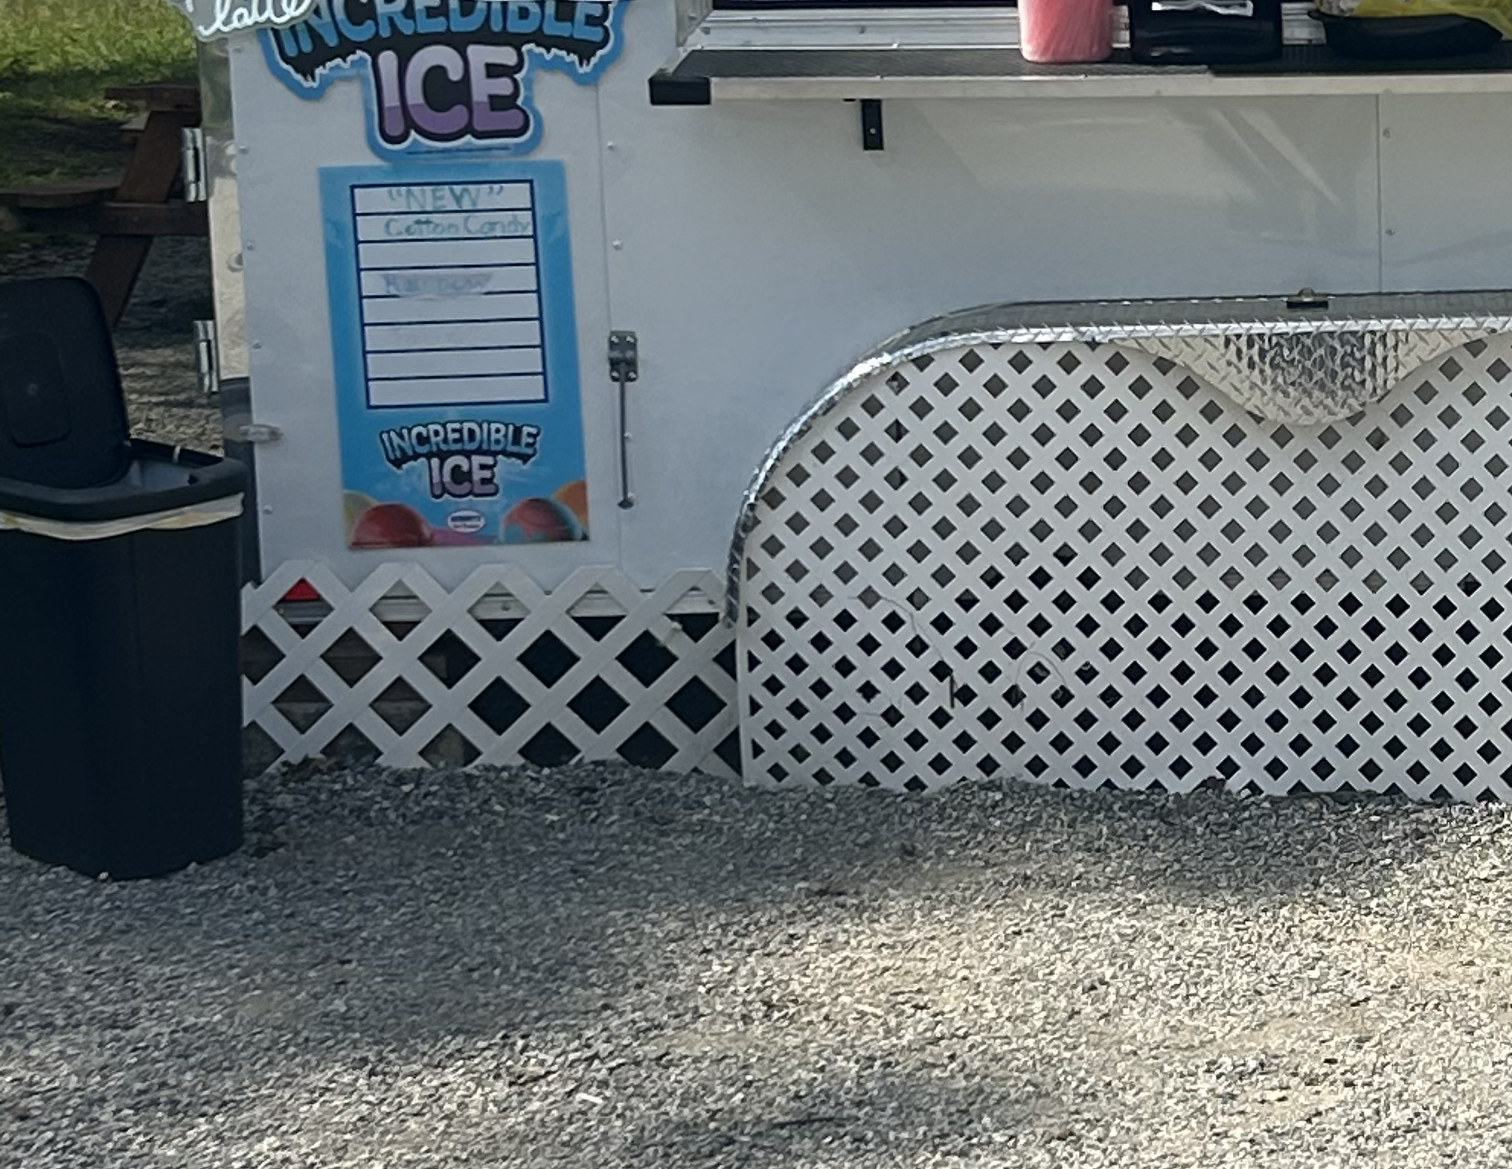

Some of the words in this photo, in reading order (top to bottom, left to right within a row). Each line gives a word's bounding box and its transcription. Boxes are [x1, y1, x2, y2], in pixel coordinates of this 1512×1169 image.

[378, 43, 525, 137] ICE
[385, 216, 460, 236] Cotton
[464, 213, 530, 236] Candy
[381, 422, 540, 459] INCREDIBLE
[430, 456, 496, 496] ICE
